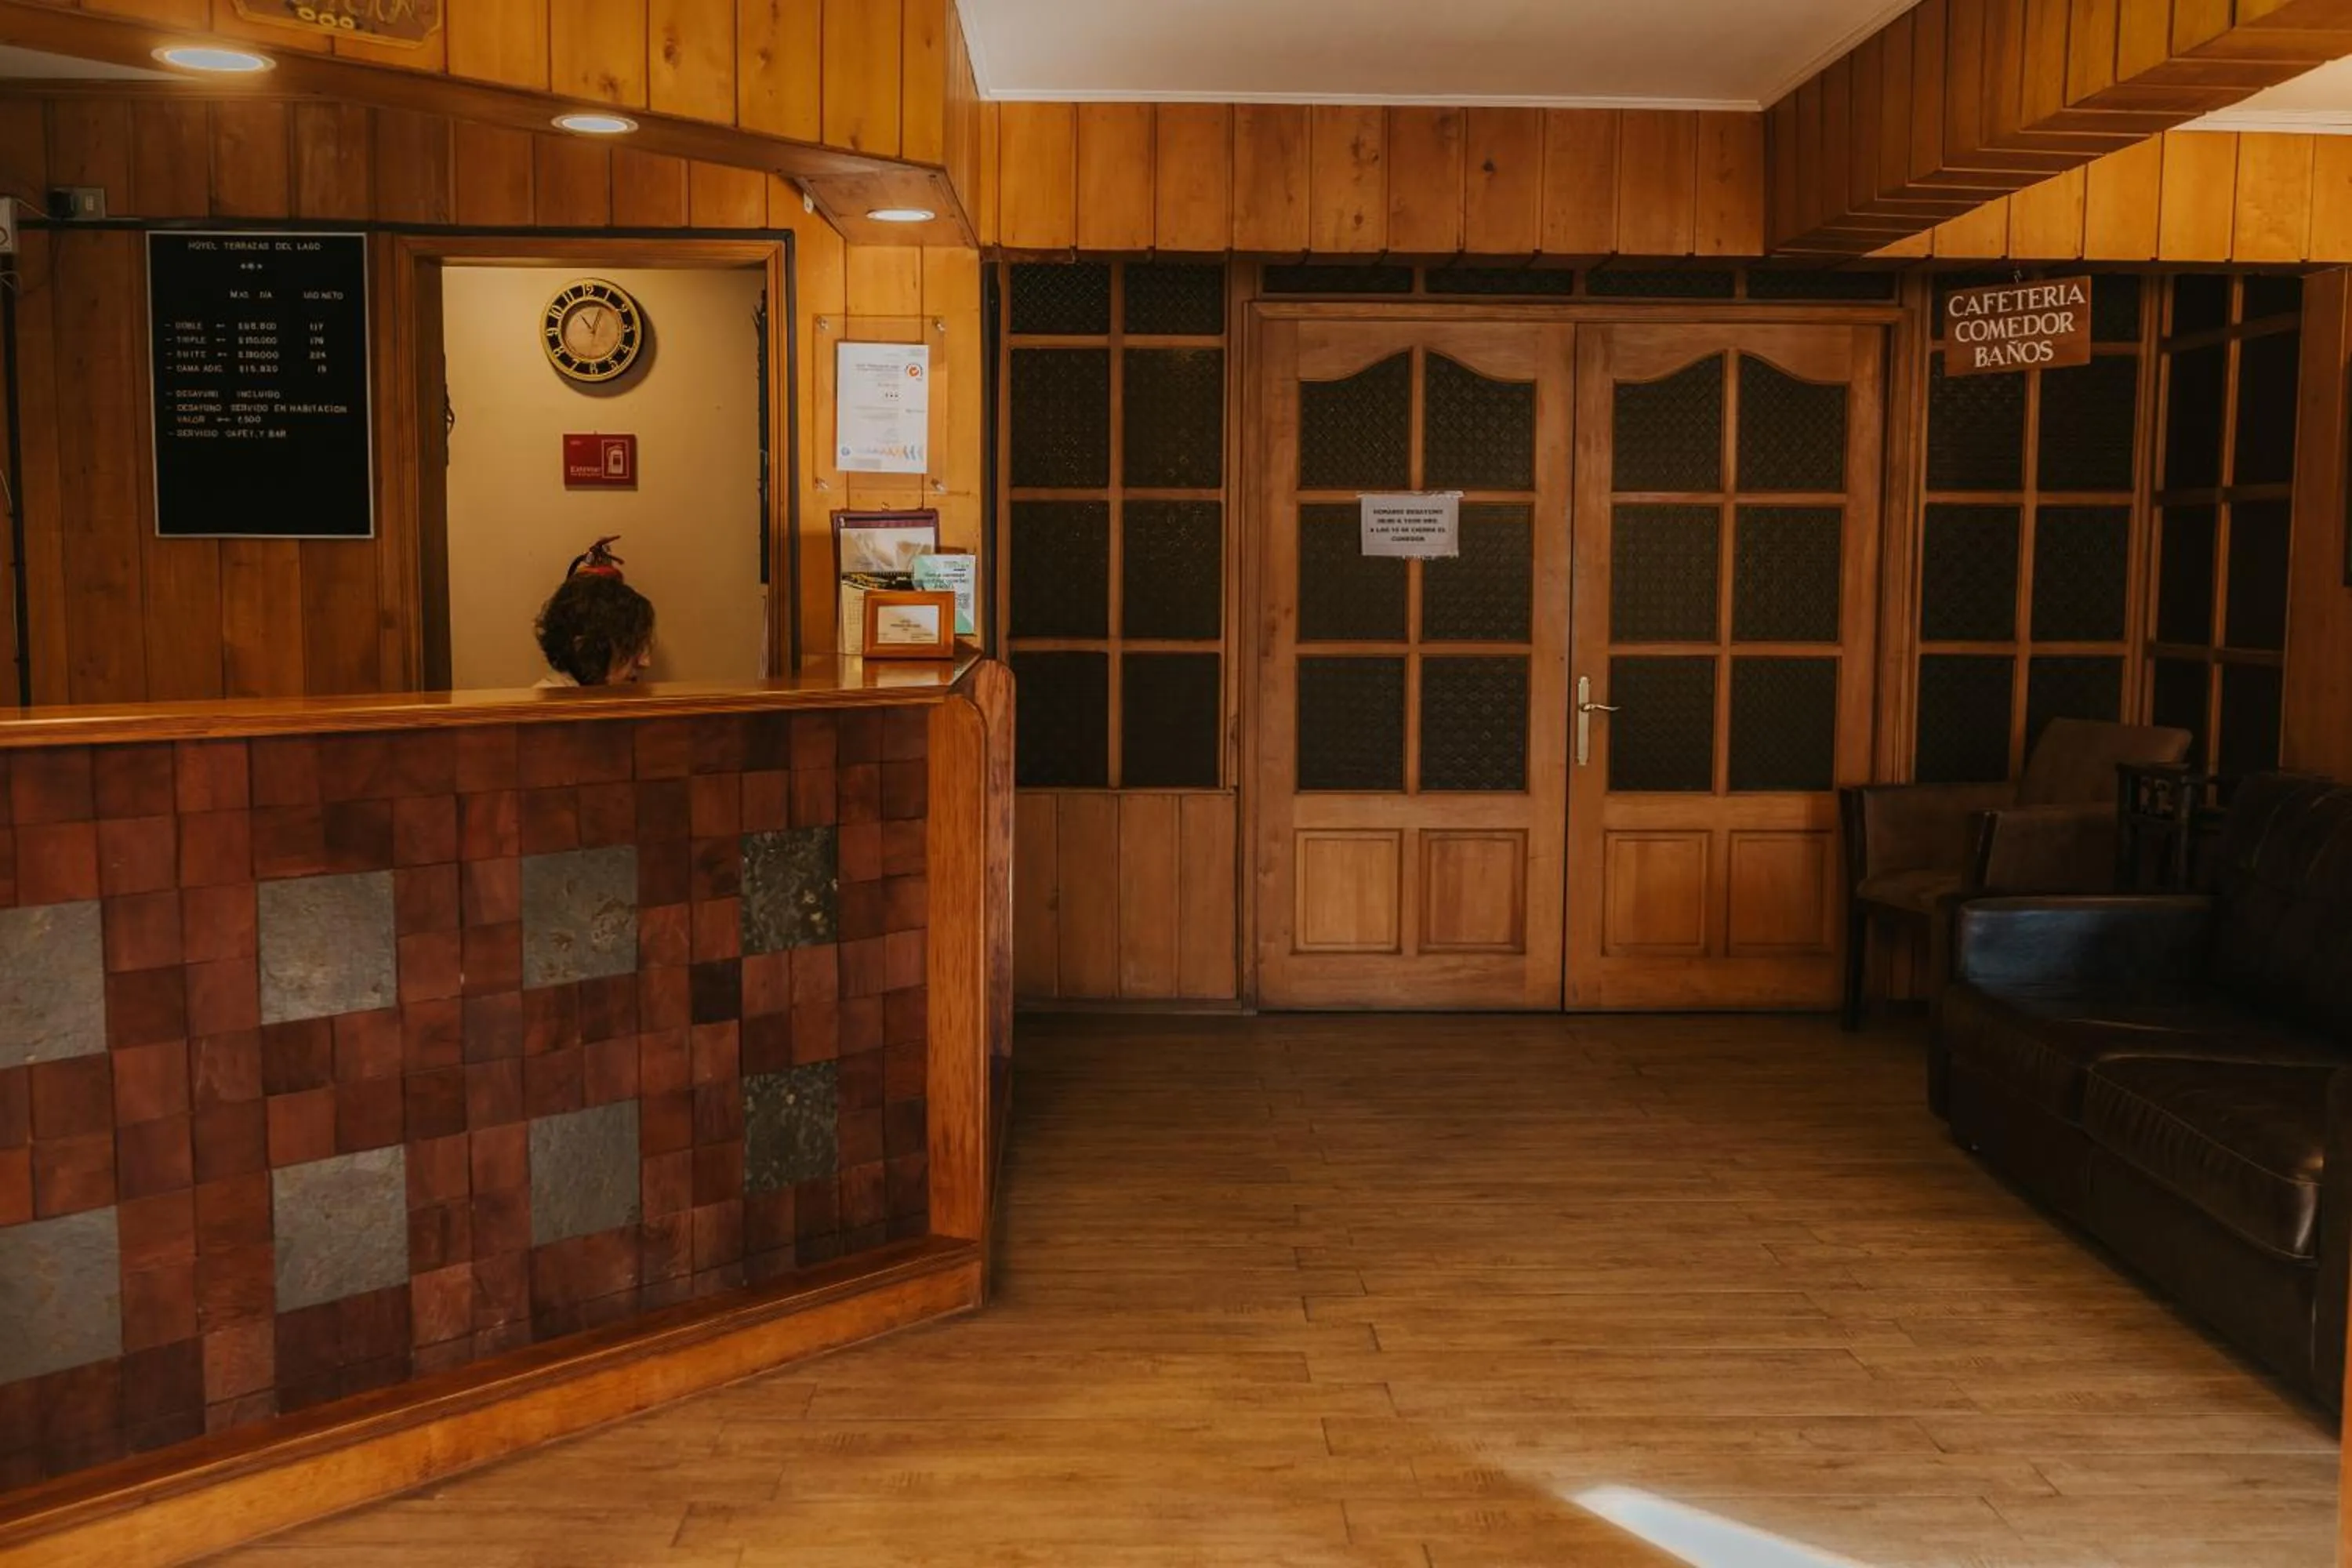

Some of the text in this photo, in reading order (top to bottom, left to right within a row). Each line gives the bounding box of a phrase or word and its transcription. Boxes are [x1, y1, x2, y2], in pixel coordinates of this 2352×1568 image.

[187, 241, 321, 251] HOTEL TERRAZAS DEL LAGO
[582, 283, 593, 297] 12
[562, 289, 574, 303] 11
[1948, 283, 2087, 318] CAFETERIA
[548, 305, 563, 318] 10
[615, 303, 628, 312] 2
[546, 327, 558, 336] 9
[1955, 311, 2075, 343] COMEDOR
[176, 350, 207, 359] SUITE
[553, 347, 564, 357] 8
[1974, 339, 2055, 368] BAÑOS
[570, 358, 581, 372] 7
[589, 361, 599, 375] 6
[606, 357, 619, 368] 5
[176, 364, 200, 373] CAMA
[236, 390, 281, 399] INCLUIDO
[176, 403, 348, 414] DESAYUNO SERVIDO EN HABITACION
[176, 415, 206, 424] VALOR
[176, 429, 220, 438] SERVICIO
[267, 430, 287, 439] BAR
